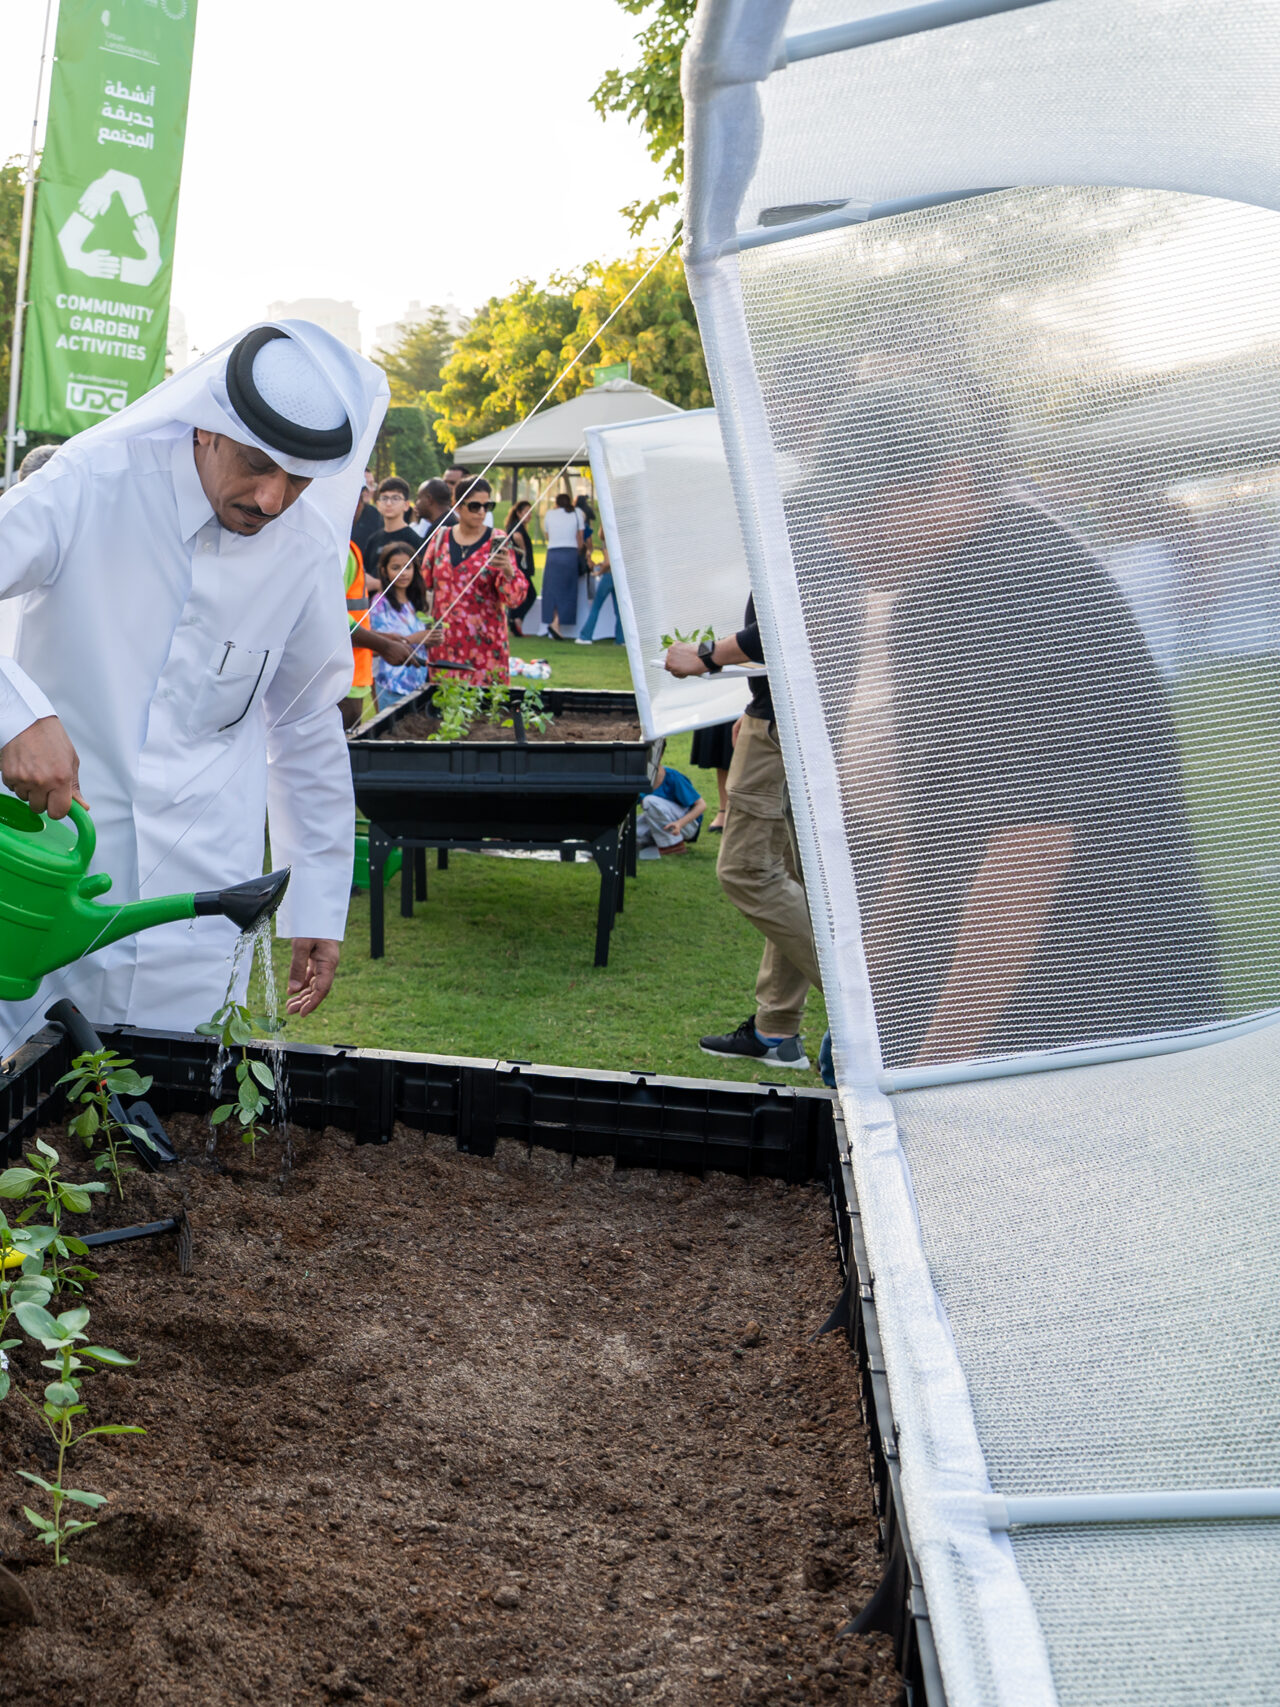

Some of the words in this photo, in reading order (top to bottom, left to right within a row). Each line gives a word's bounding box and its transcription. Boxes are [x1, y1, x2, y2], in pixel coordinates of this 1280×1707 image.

[104, 80, 156, 106] أنشطة
[101, 102, 154, 128] حديقة
[97, 126, 154, 150] المجتمع
[55, 293, 154, 323] COMMUNITY
[70, 315, 139, 340] GARDEN
[55, 333, 147, 361] ACTIVITIES
[69, 385, 124, 412] UDC
